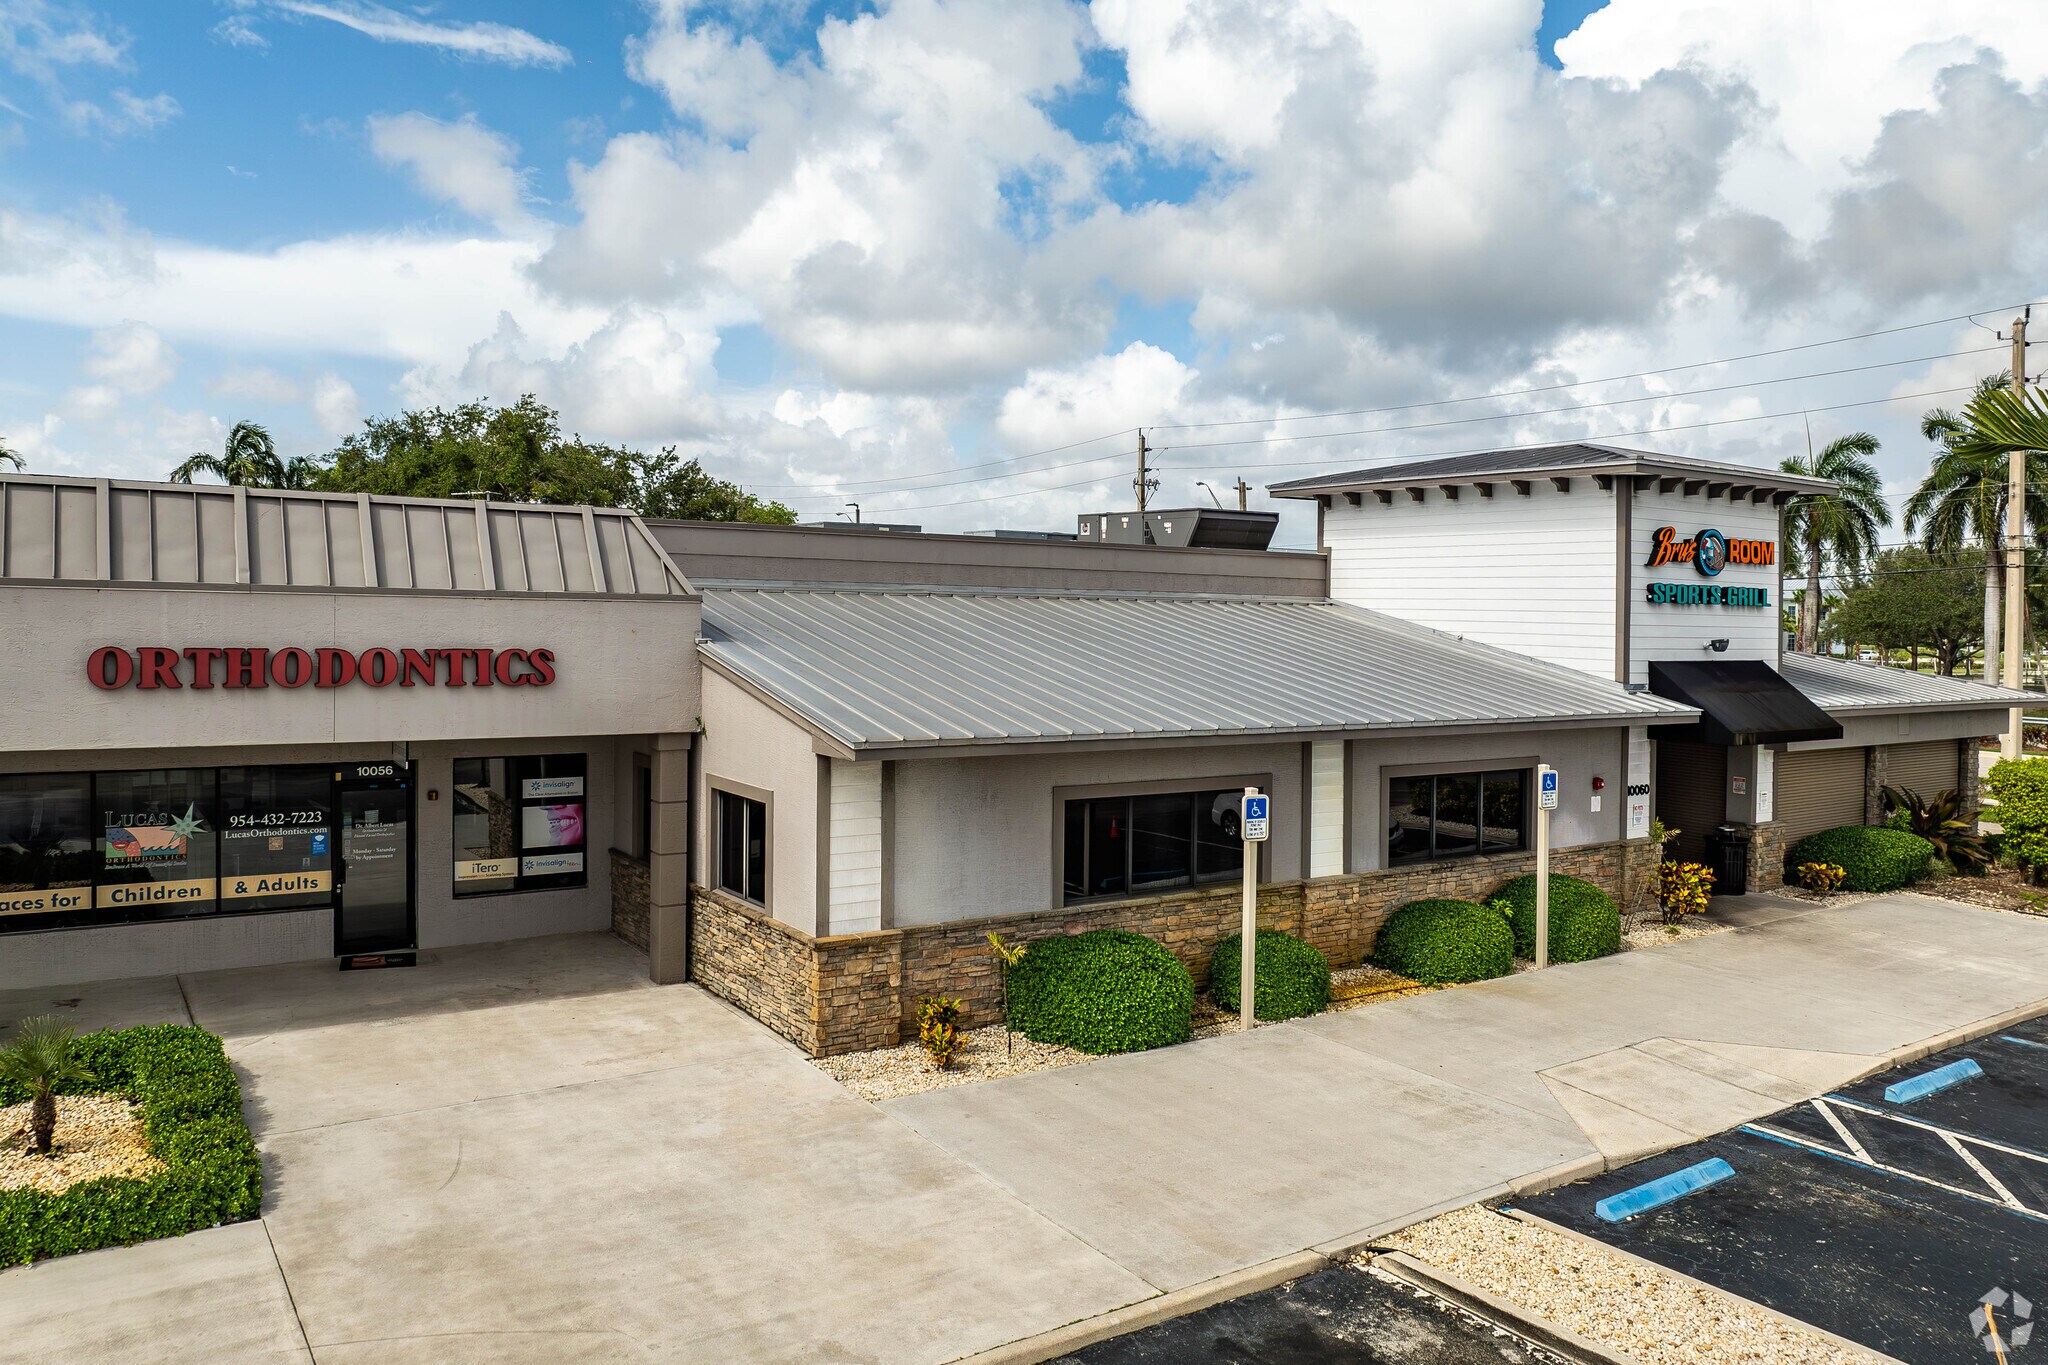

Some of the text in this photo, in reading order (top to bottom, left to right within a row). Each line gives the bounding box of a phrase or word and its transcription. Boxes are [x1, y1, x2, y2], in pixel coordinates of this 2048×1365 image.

[1729, 539, 1775, 565] ROOM
[1651, 583, 1772, 607] SPORTS GRILL
[87, 646, 556, 690] ORTHODONTICS
[356, 765, 394, 777] 10056
[543, 780, 574, 789] invisalign
[1628, 784, 1650, 796] 10060
[105, 811, 168, 828] LUCAS
[230, 811, 322, 828] 954-432-7223
[225, 827, 328, 839] LucasOrthodontics.com
[105, 854, 187, 864] ORTHODONTICS
[536, 859, 566, 867] invisalign
[472, 863, 498, 874] iTero
[0, 876, 319, 912] aces for Children & Adults
